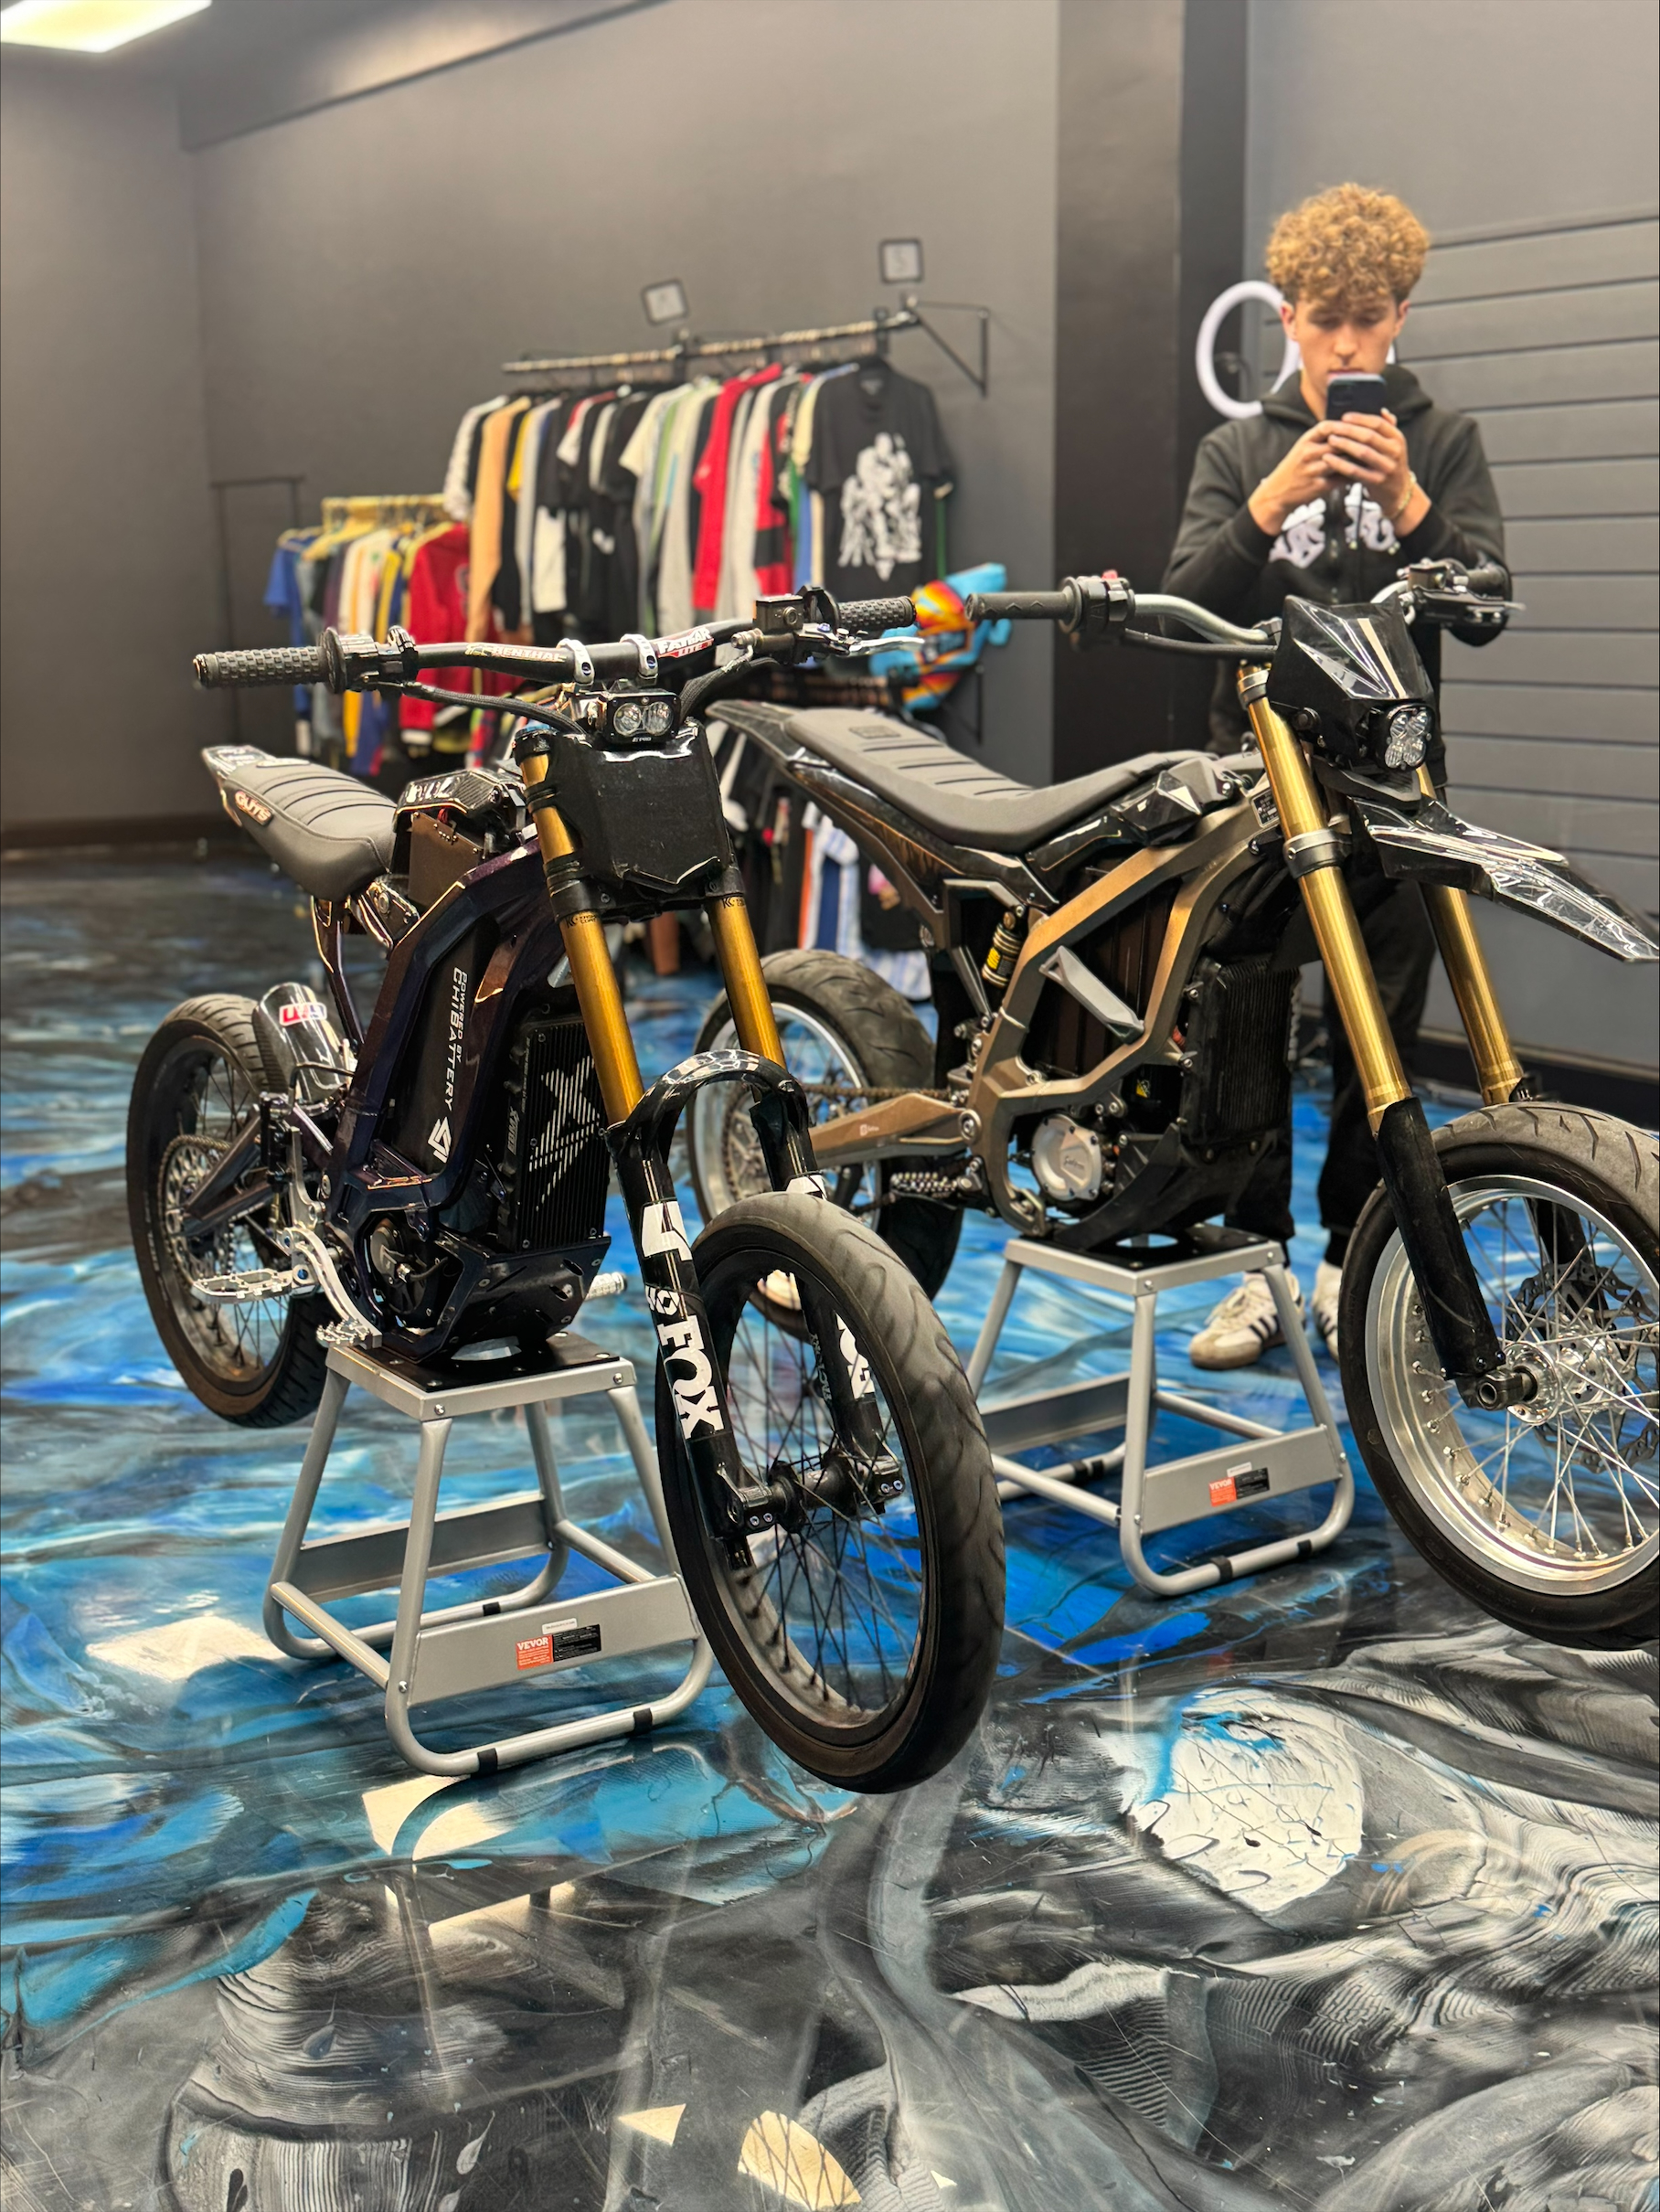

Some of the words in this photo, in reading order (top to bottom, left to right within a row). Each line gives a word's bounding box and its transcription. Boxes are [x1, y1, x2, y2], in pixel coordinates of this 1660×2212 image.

[491, 646, 565, 663] RENTHAL
[234, 791, 271, 821] GUTS
[457, 971, 468, 1040] POWERED
[444, 966, 463, 1111] CHIBATTERY
[456, 1044, 463, 1064] BY
[657, 1314, 725, 1440] FOX
[1208, 1478, 1232, 1491] VEVOR
[516, 1636, 549, 1651] VEVOR
